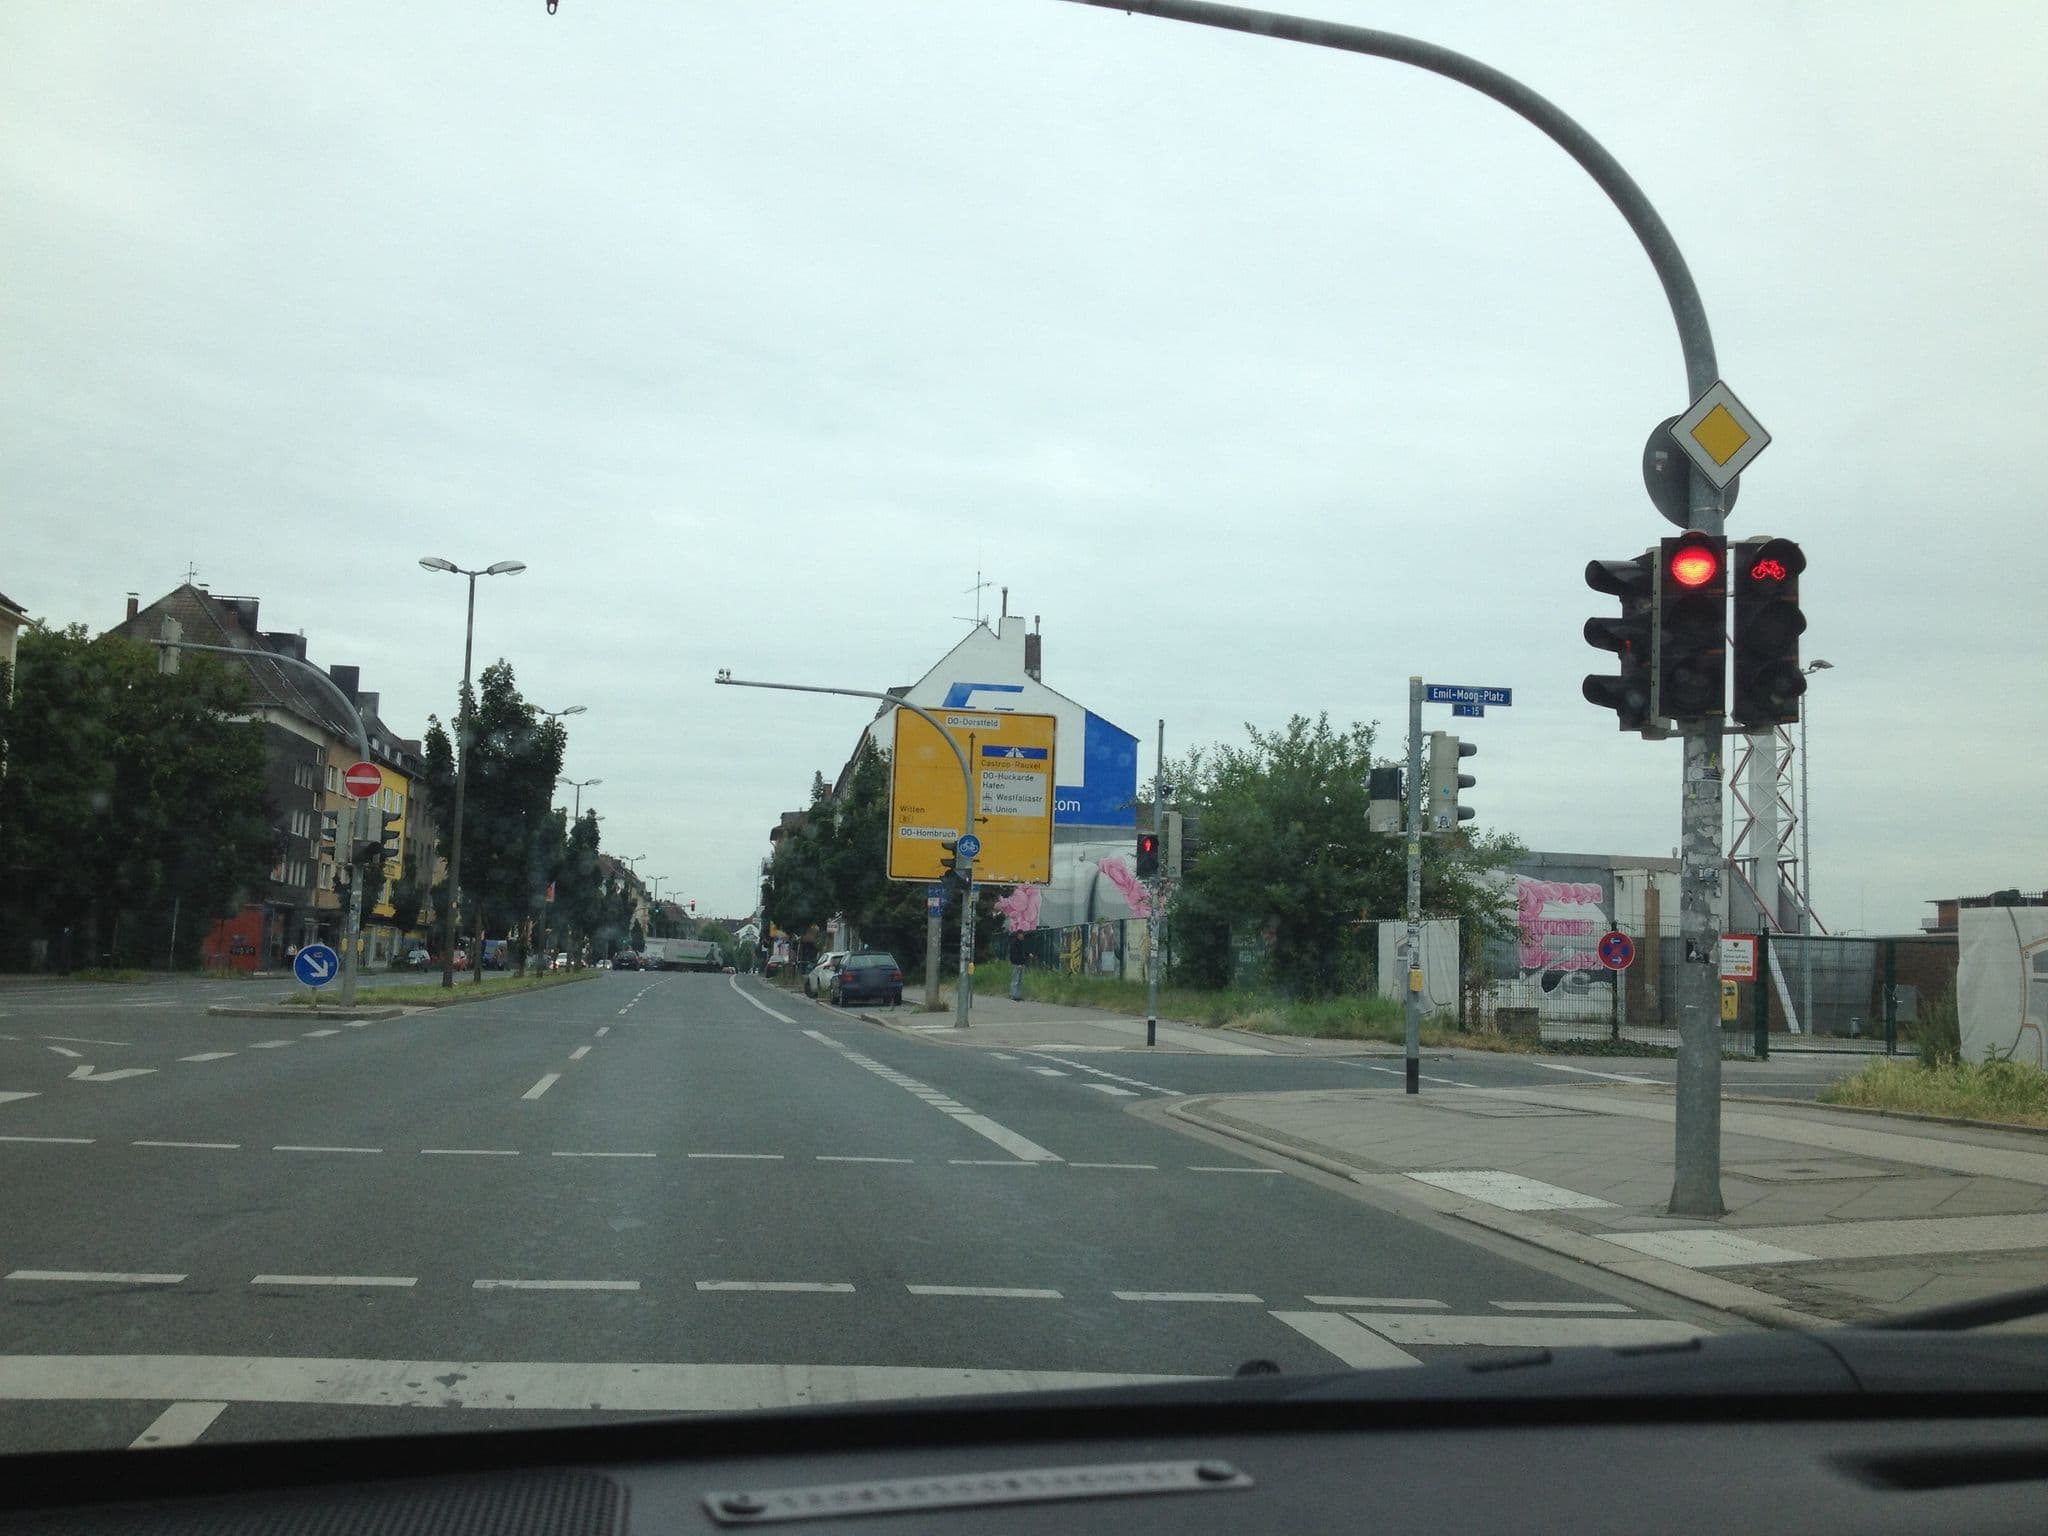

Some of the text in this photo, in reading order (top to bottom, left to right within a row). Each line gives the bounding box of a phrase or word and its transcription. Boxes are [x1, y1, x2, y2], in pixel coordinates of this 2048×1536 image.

[1433, 688, 1505, 703] Emil-Moog-Platz
[947, 717, 999, 727] DO-Dorstfeld
[981, 760, 1041, 770] Castrop-Rauxel
[983, 772, 1034, 781] DO-Huckarde
[995, 805, 1018, 813] Union
[901, 828, 957, 838] DO-Hombruch
